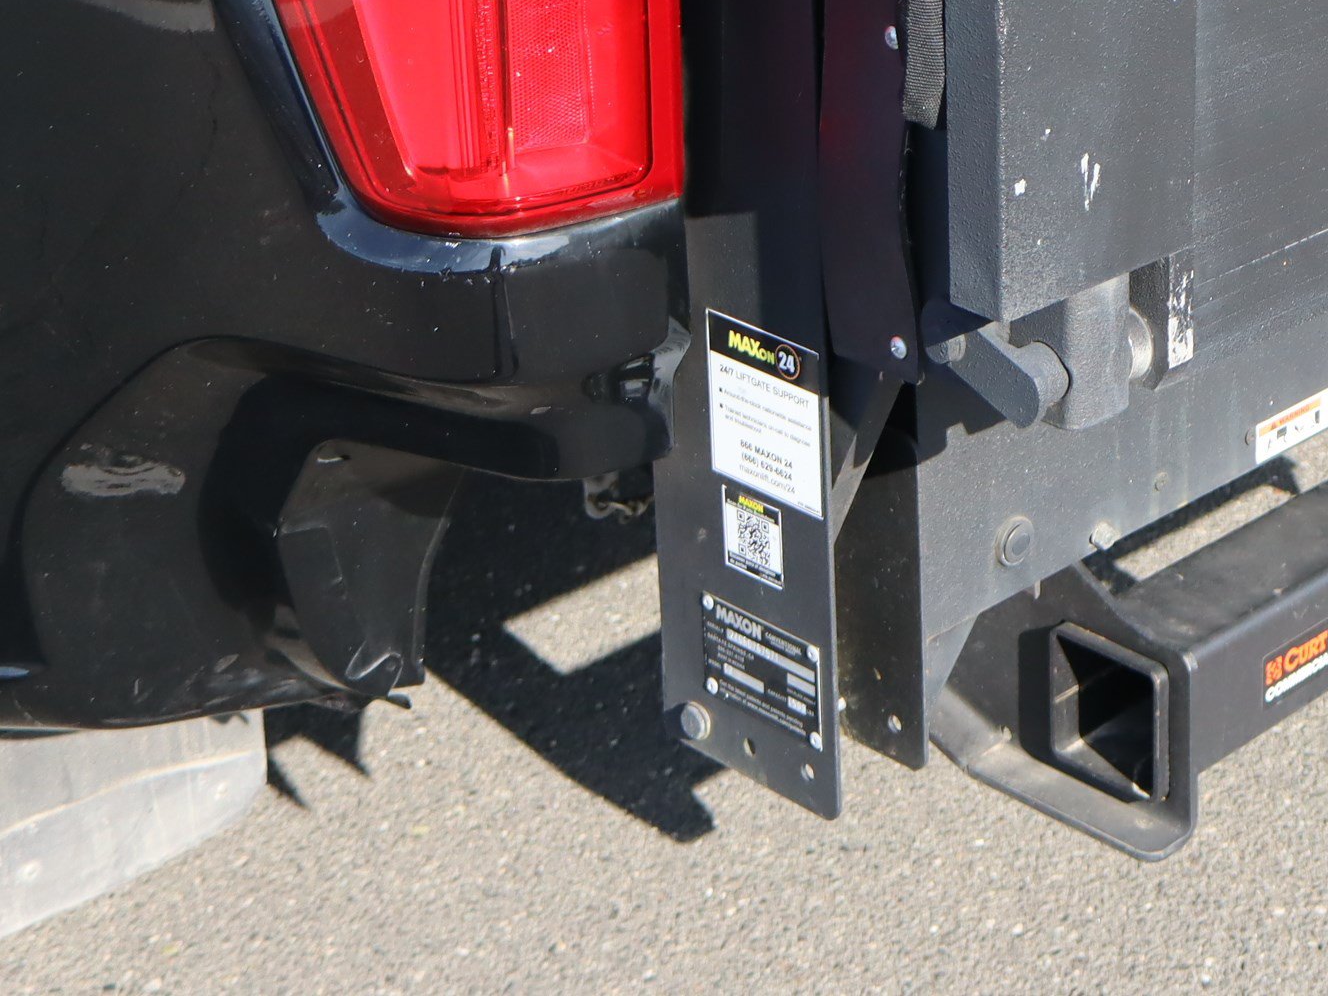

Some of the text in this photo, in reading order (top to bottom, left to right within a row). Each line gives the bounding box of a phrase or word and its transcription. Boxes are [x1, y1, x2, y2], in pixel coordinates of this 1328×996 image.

[778, 350, 795, 374] 24
[719, 363, 808, 408] 24/7 LIFTGATE SUPPORT
[754, 445, 782, 464] MAXON
[784, 458, 792, 469] 24
[715, 603, 762, 641] MAXON
[1284, 629, 1328, 673] CURT
